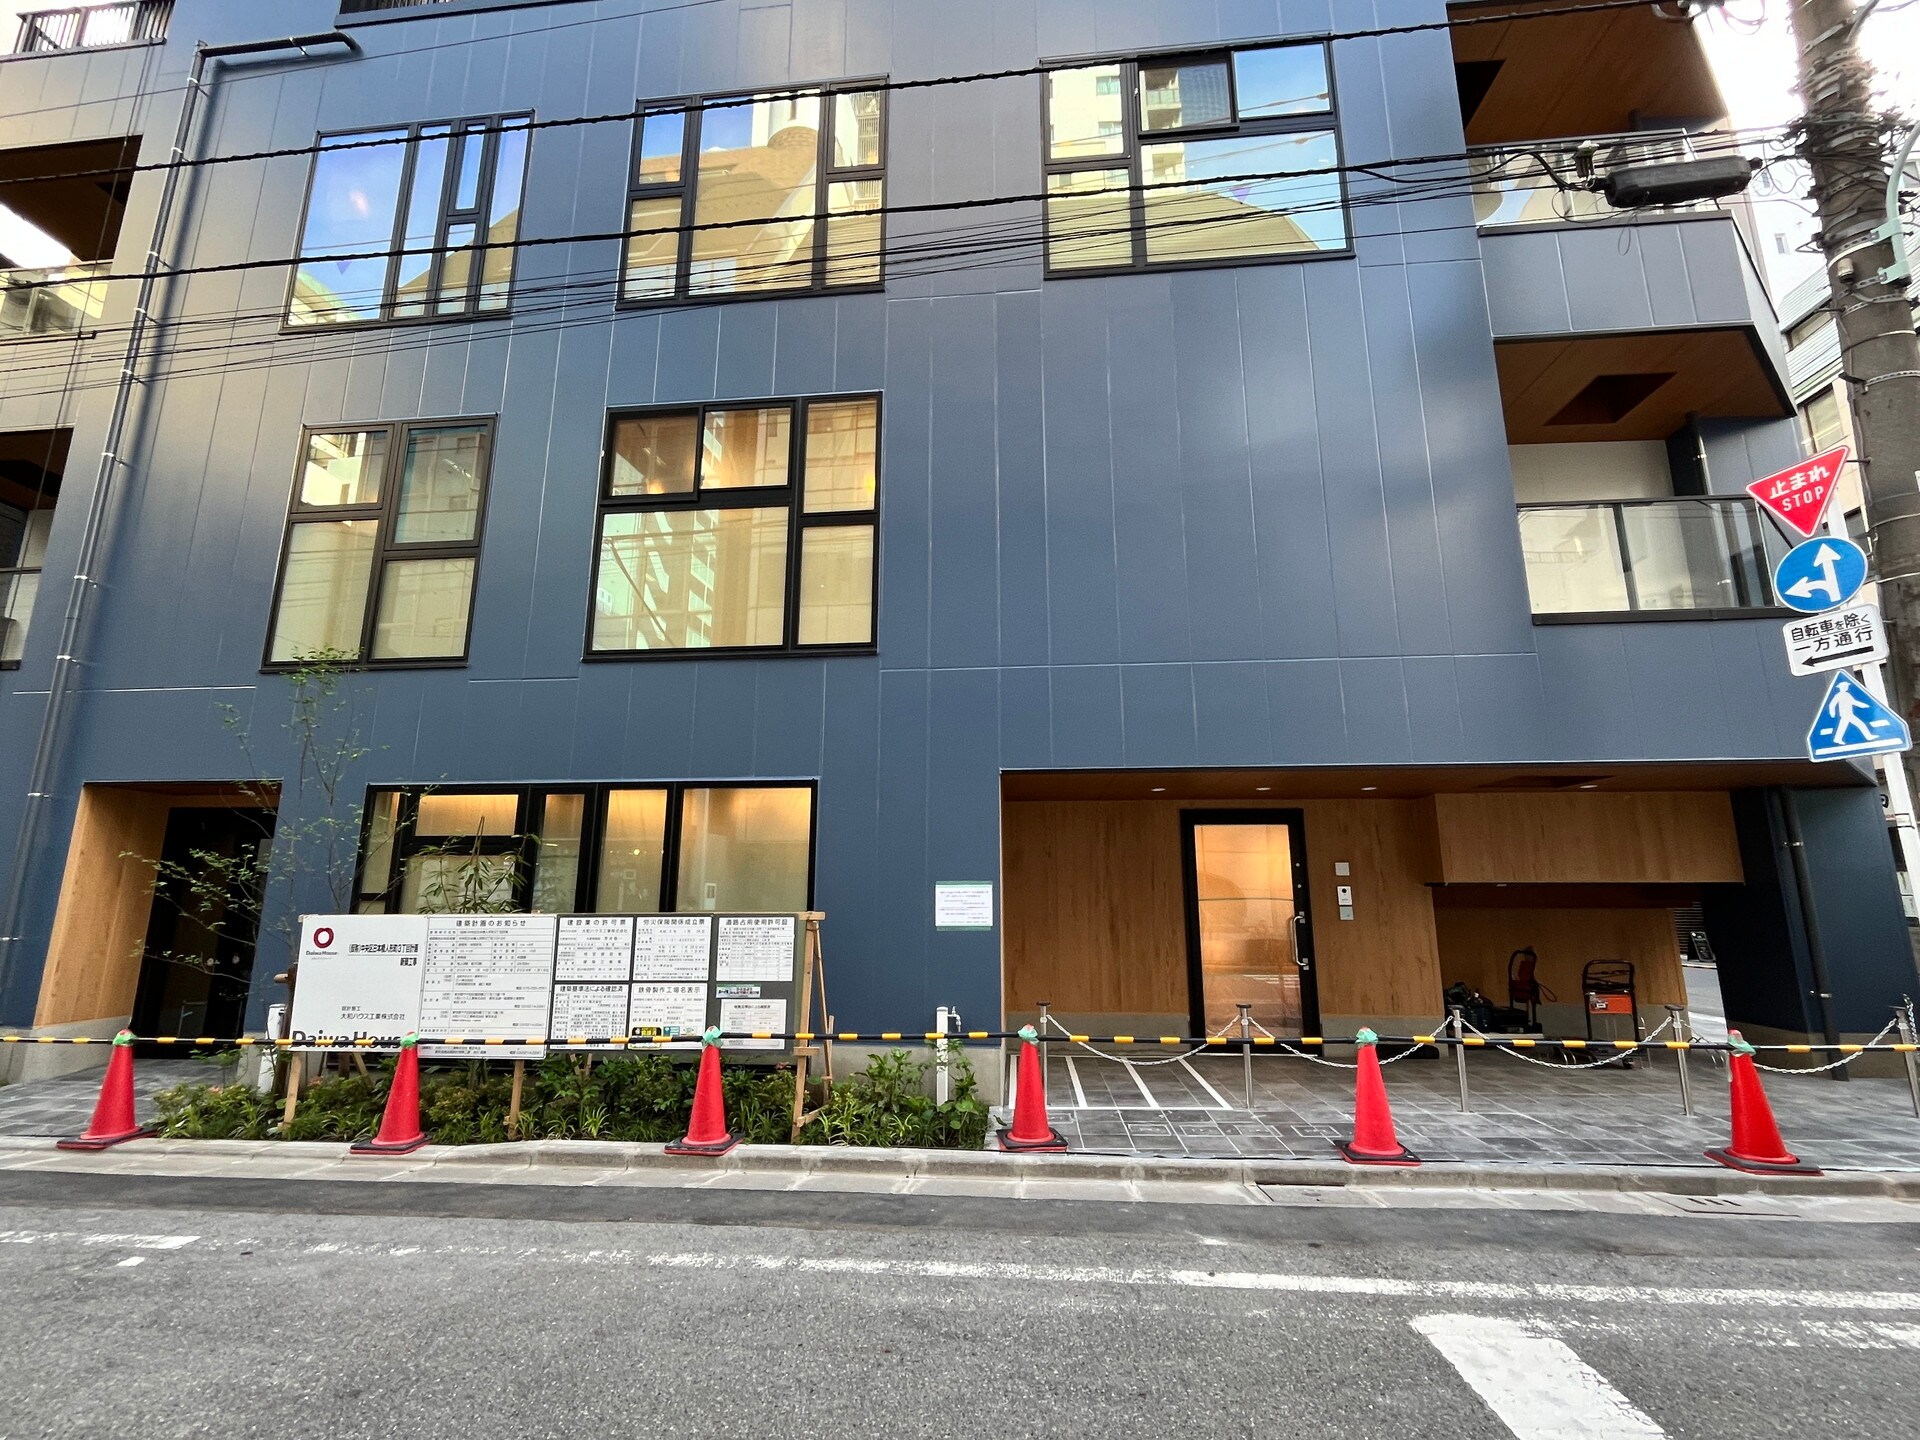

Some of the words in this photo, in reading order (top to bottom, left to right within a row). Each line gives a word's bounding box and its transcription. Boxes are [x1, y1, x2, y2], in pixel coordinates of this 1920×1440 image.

[1769, 465, 1831, 499] 止まれ
[1782, 485, 1824, 512] STOP
[1791, 613, 1871, 641] 自転車を除く
[1794, 626, 1874, 652] 一方通行
[353, 1032, 402, 1048] Hous
